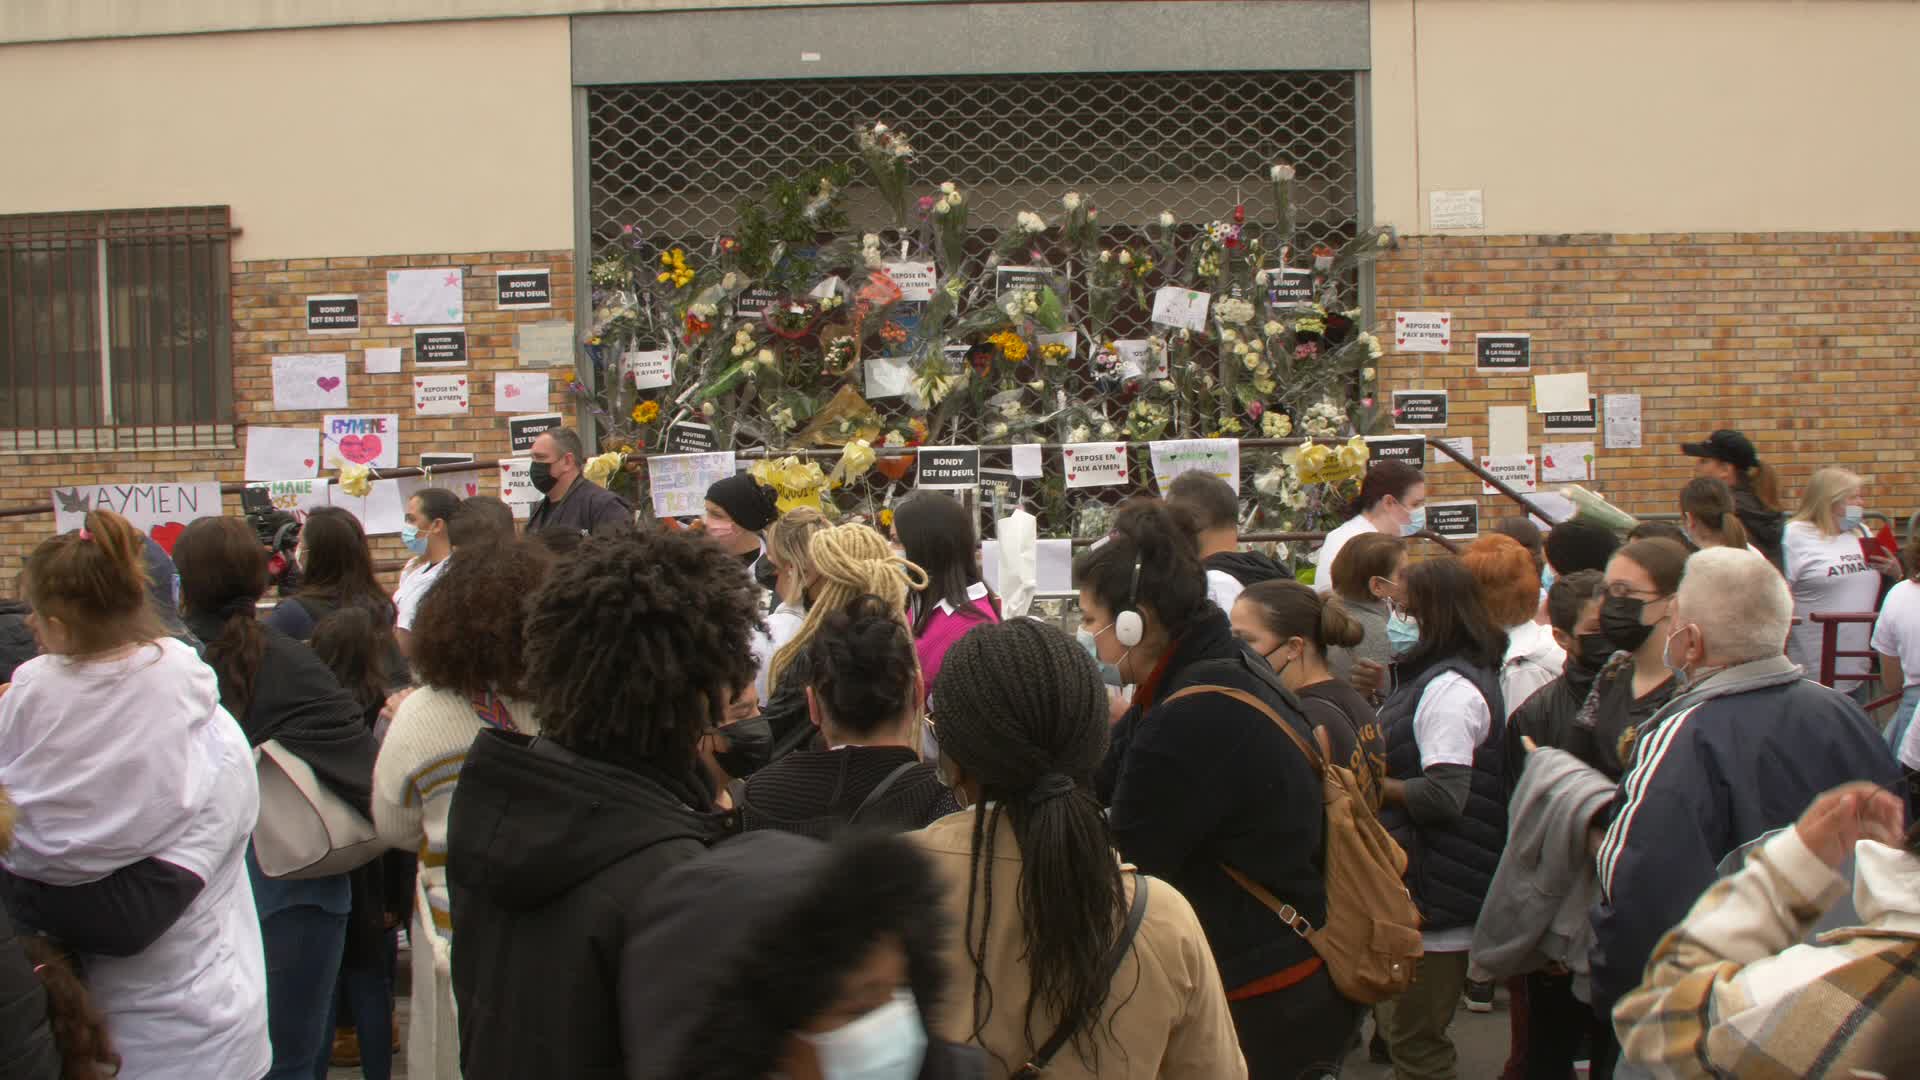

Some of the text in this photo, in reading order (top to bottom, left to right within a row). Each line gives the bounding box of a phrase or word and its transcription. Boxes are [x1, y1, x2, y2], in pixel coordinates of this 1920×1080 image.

[510, 280, 537, 289] BONDY
[501, 291, 514, 299] EST
[1278, 289, 1289, 297] EN
[741, 298, 754, 306] EST
[319, 306, 346, 314] BONDY
[311, 316, 324, 324] EST
[335, 315, 357, 323] DEUIL
[522, 425, 549, 434] BONDY
[1379, 447, 1410, 456] BONDY
[1075, 453, 1116, 462] REPOSE EN
[933, 458, 964, 466] BONDY
[1092, 463, 1120, 471] AYMEN
[511, 470, 530, 478] REPO
[922, 468, 975, 477] EST EN DEUIL
[96, 484, 198, 514] AYMEN
